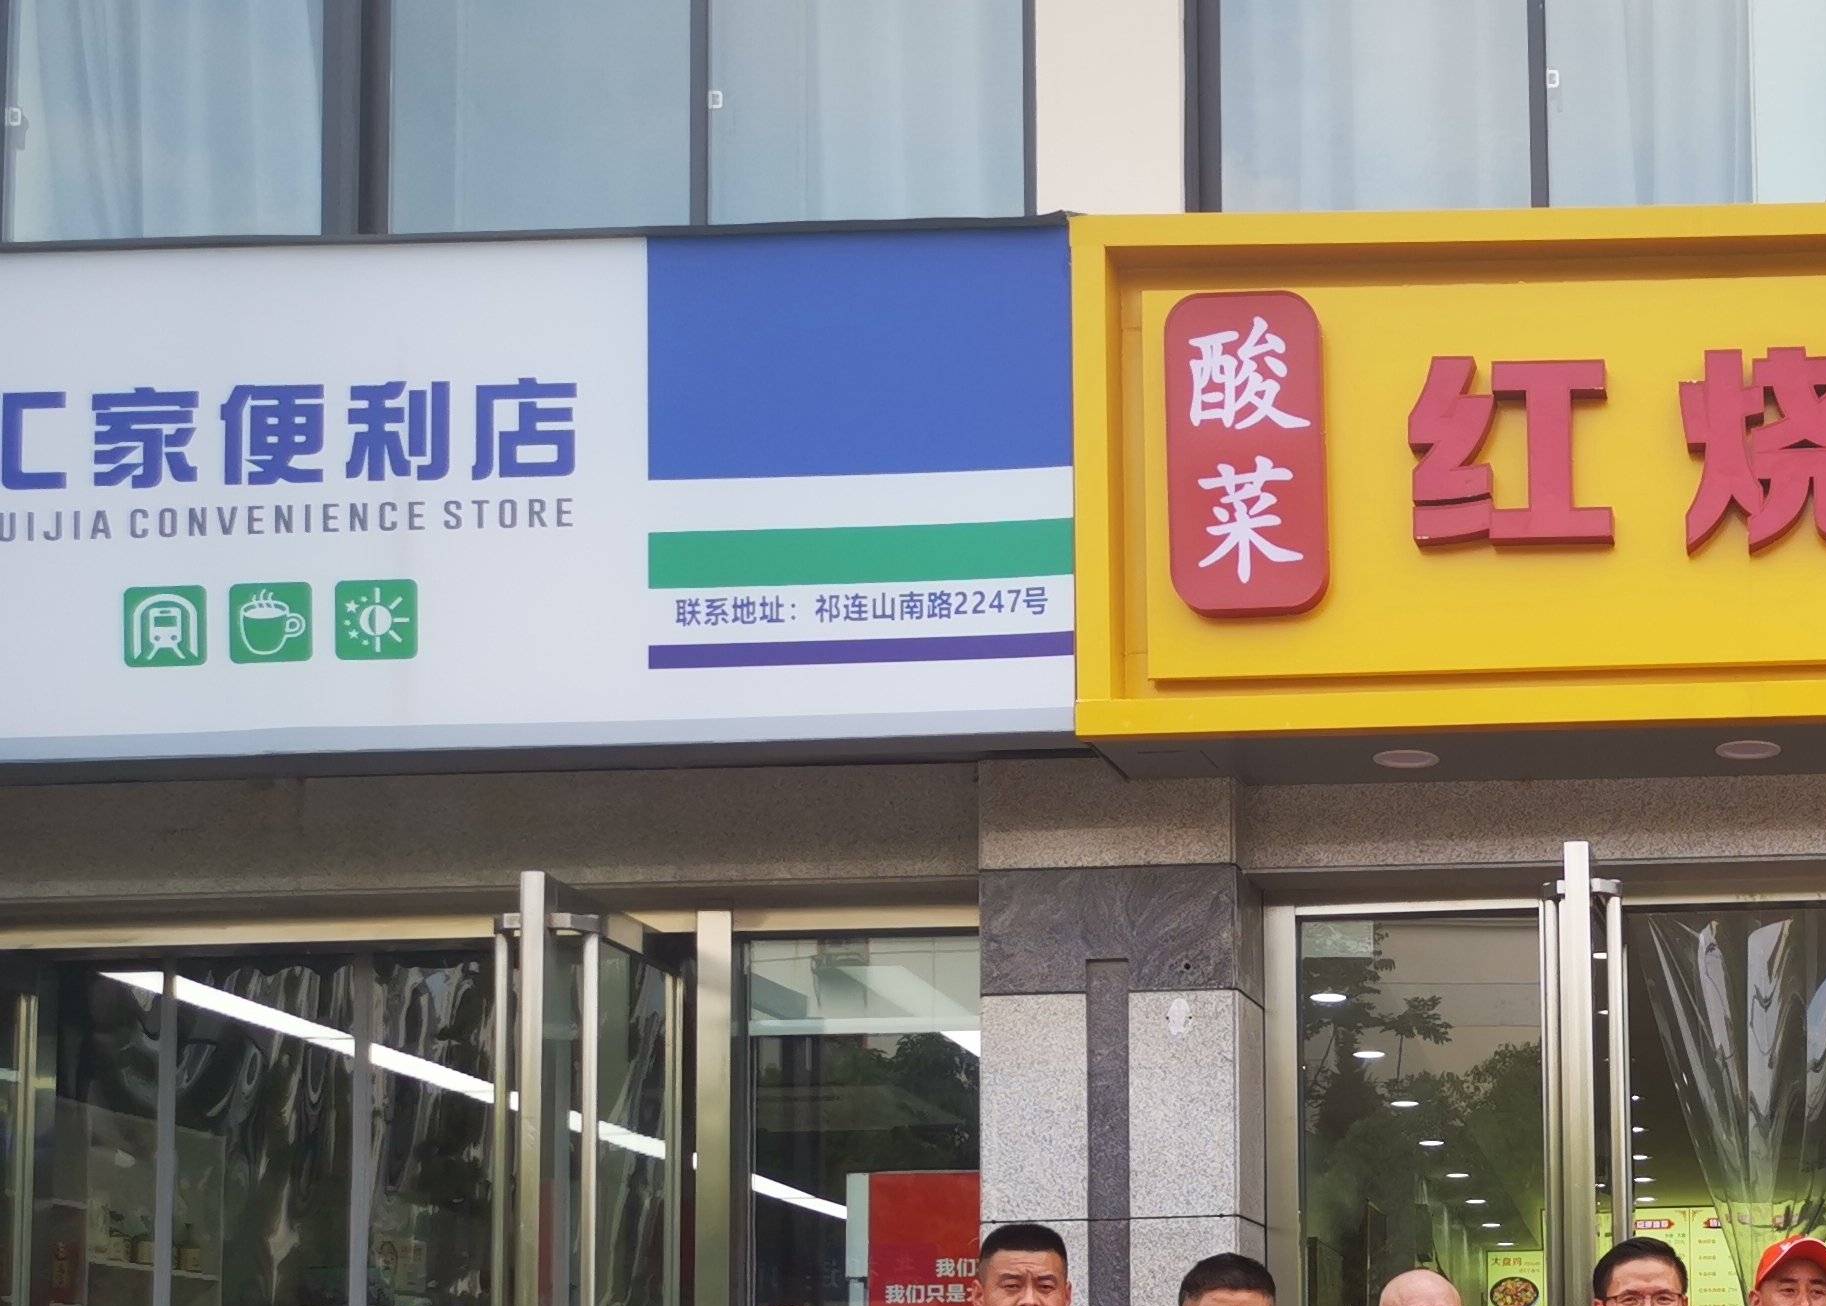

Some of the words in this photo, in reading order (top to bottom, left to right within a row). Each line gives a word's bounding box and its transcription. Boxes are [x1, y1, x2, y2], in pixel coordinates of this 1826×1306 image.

[1186, 311, 1313, 586] 酸菜
[128, 500, 428, 539] CONVENIENCE
[441, 496, 576, 532] STORE
[935, 1257, 979, 1279] 我们
